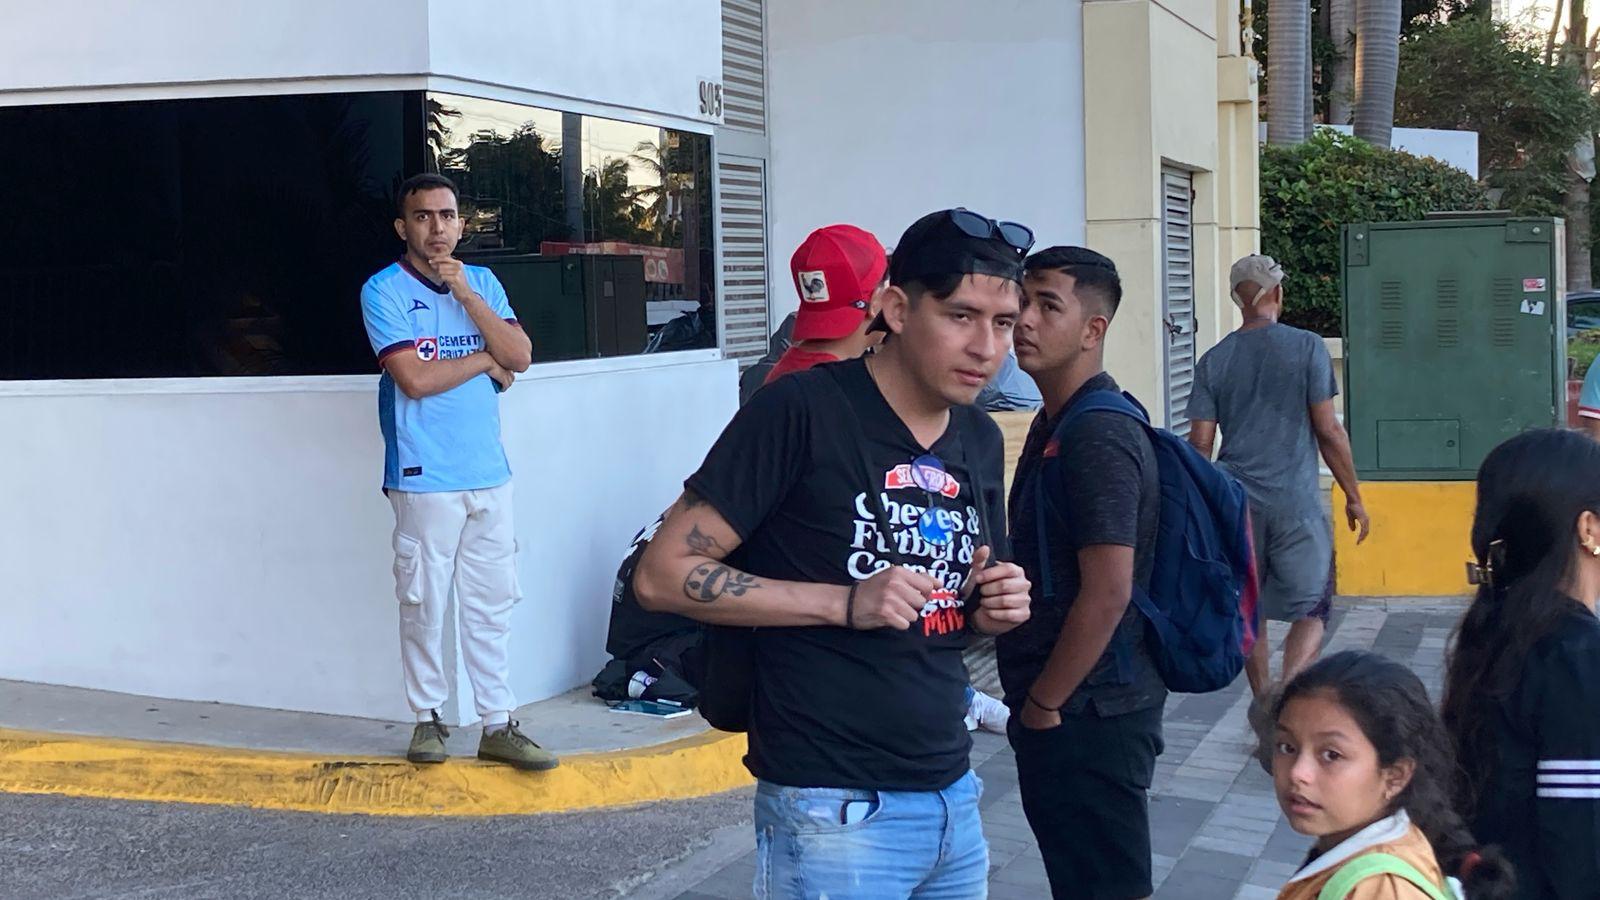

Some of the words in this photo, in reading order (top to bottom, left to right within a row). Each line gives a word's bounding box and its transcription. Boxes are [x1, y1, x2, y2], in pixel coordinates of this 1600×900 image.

[700, 81, 722, 117] 905
[966, 505, 980, 535] &
[957, 534, 974, 564] &
